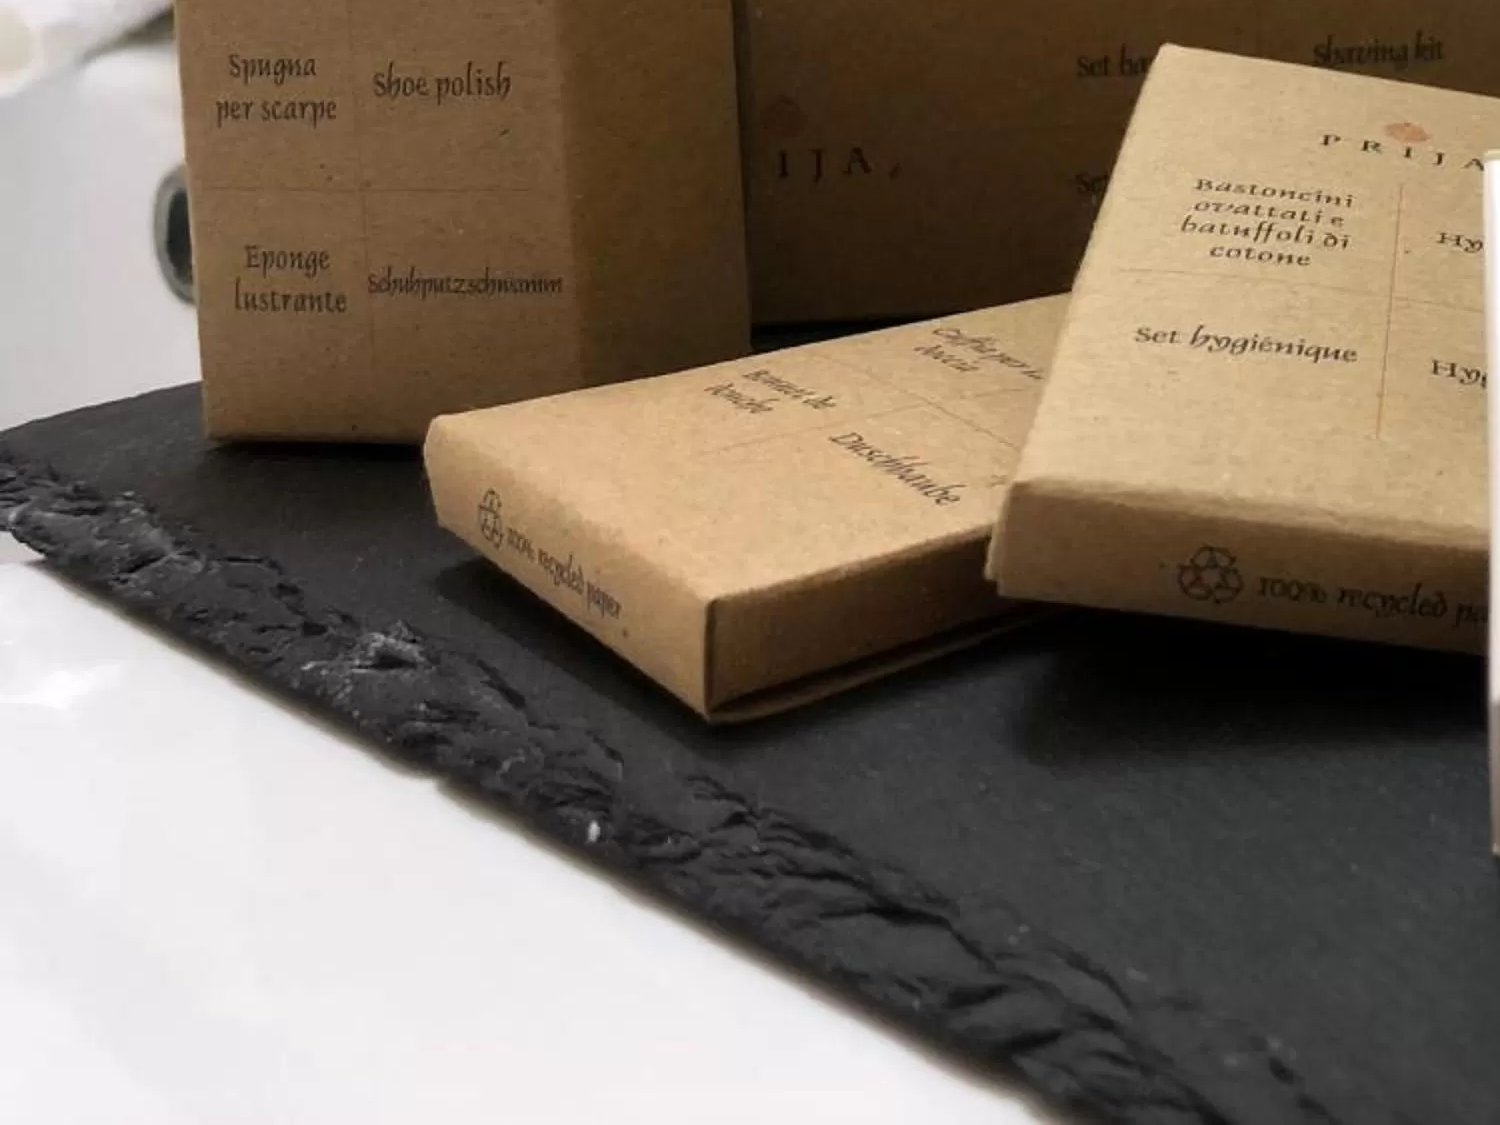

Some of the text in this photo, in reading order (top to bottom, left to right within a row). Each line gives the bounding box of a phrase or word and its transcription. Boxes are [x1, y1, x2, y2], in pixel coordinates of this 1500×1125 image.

[1414, 29, 1444, 62] kit
[228, 53, 317, 86] Spugna
[1076, 53, 1112, 77] Set
[436, 60, 513, 106] polish
[215, 99, 338, 129] per scarpe
[776, 146, 874, 187] IJA
[1318, 133, 1485, 172] PRIJA
[1191, 178, 1357, 209] Bastoncini
[1179, 214, 1315, 245] batuffoli
[1192, 200, 1345, 227] ovattati e
[245, 245, 331, 273] Eponge
[1208, 245, 1312, 267] cotone
[1436, 231, 1484, 254] Hy
[234, 274, 347, 313] lustrante
[367, 265, 565, 302] Schuhputzschwamm
[1134, 324, 1359, 365] Set hygiénique
[828, 431, 970, 507] Duschhaube
[586, 579, 623, 620] paper
[1336, 581, 1450, 619] recycled
[1454, 601, 1490, 628] pa
